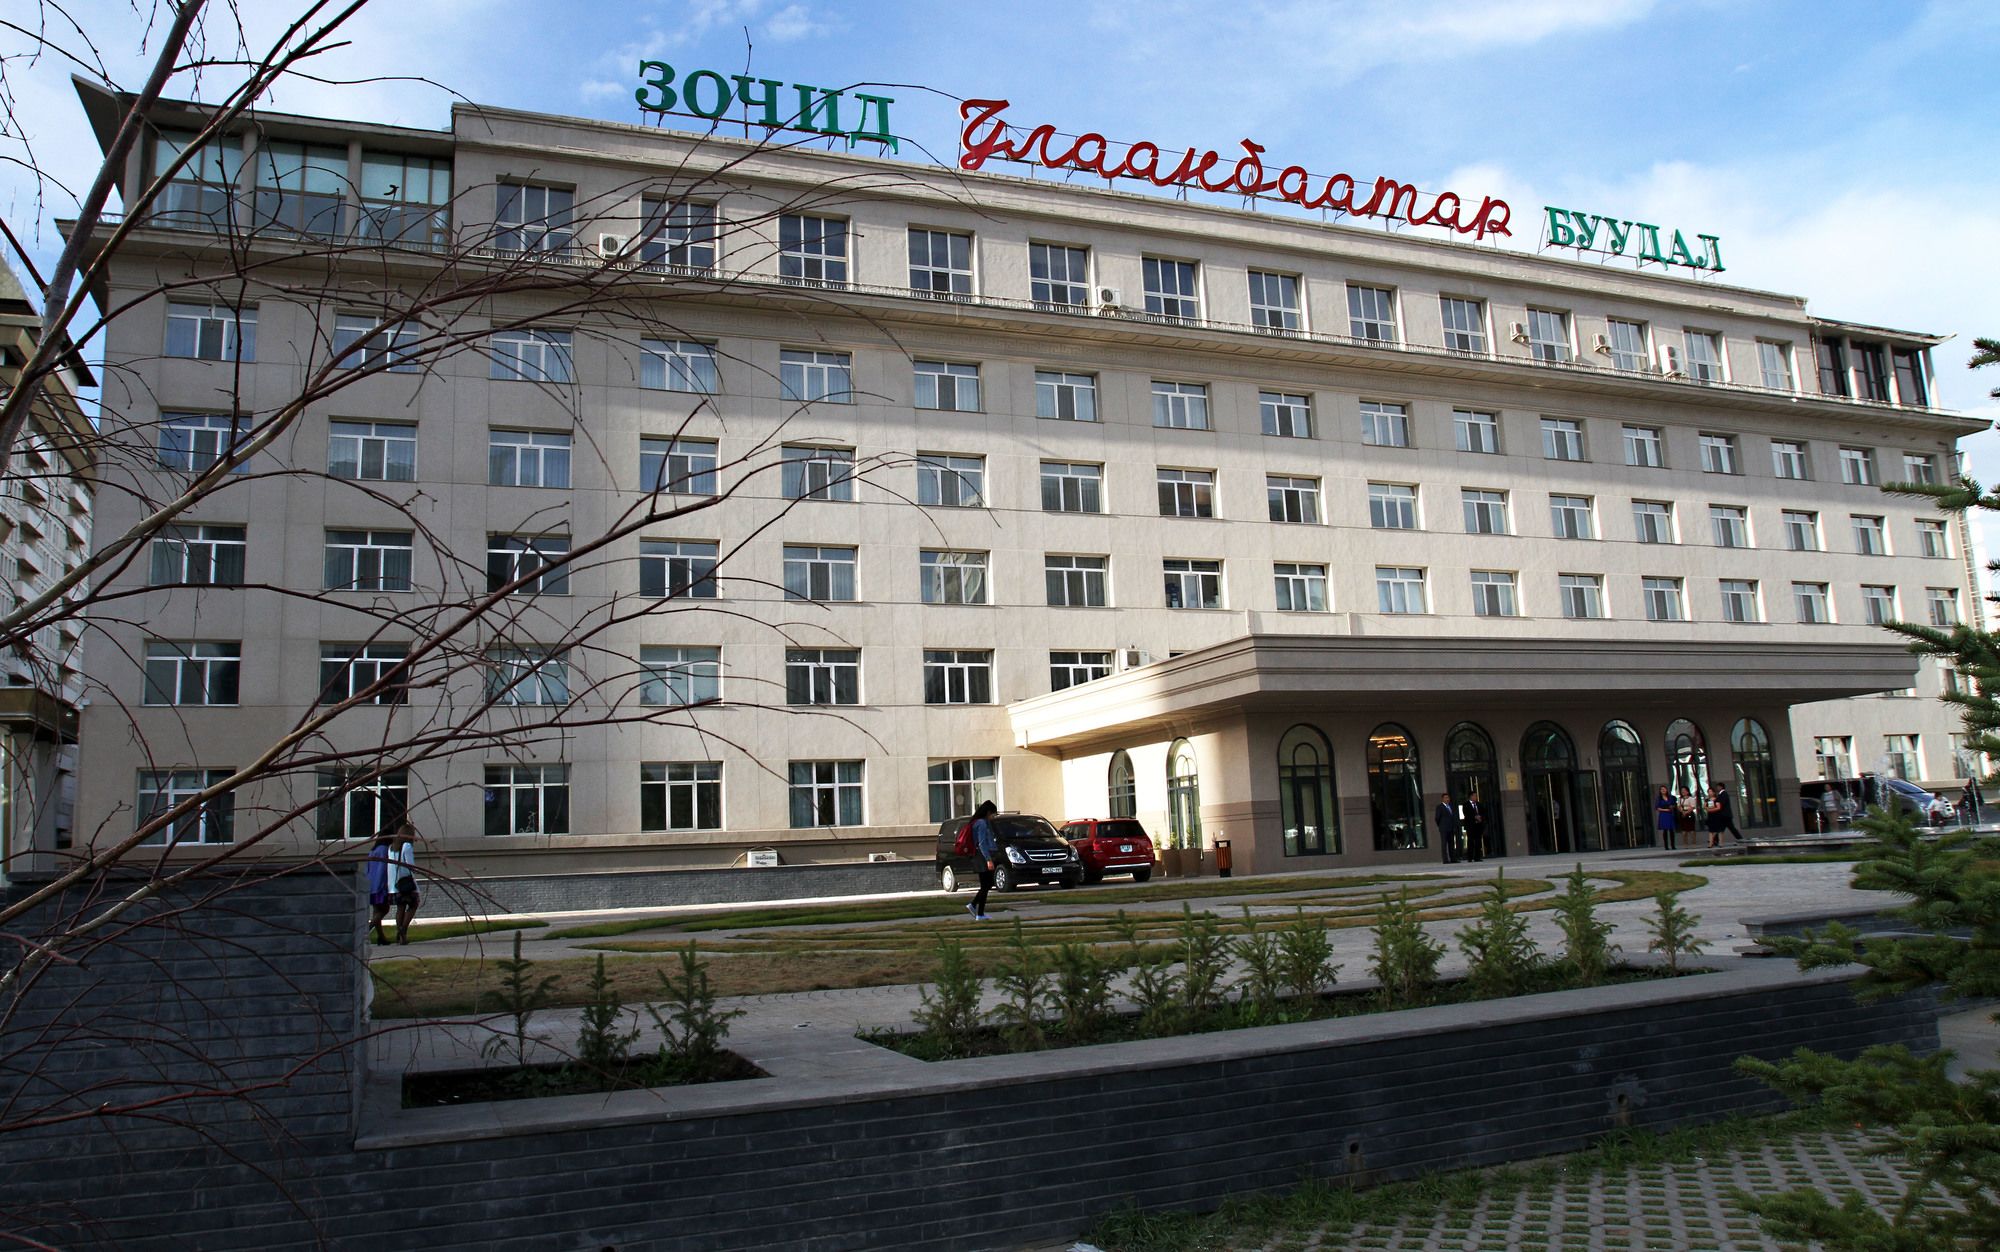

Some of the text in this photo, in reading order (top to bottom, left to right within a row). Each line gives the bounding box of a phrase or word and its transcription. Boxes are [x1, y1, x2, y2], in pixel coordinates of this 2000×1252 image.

[635, 60, 1726, 271] ЗОЧИД Улаанбаатар БУУДАЛ
